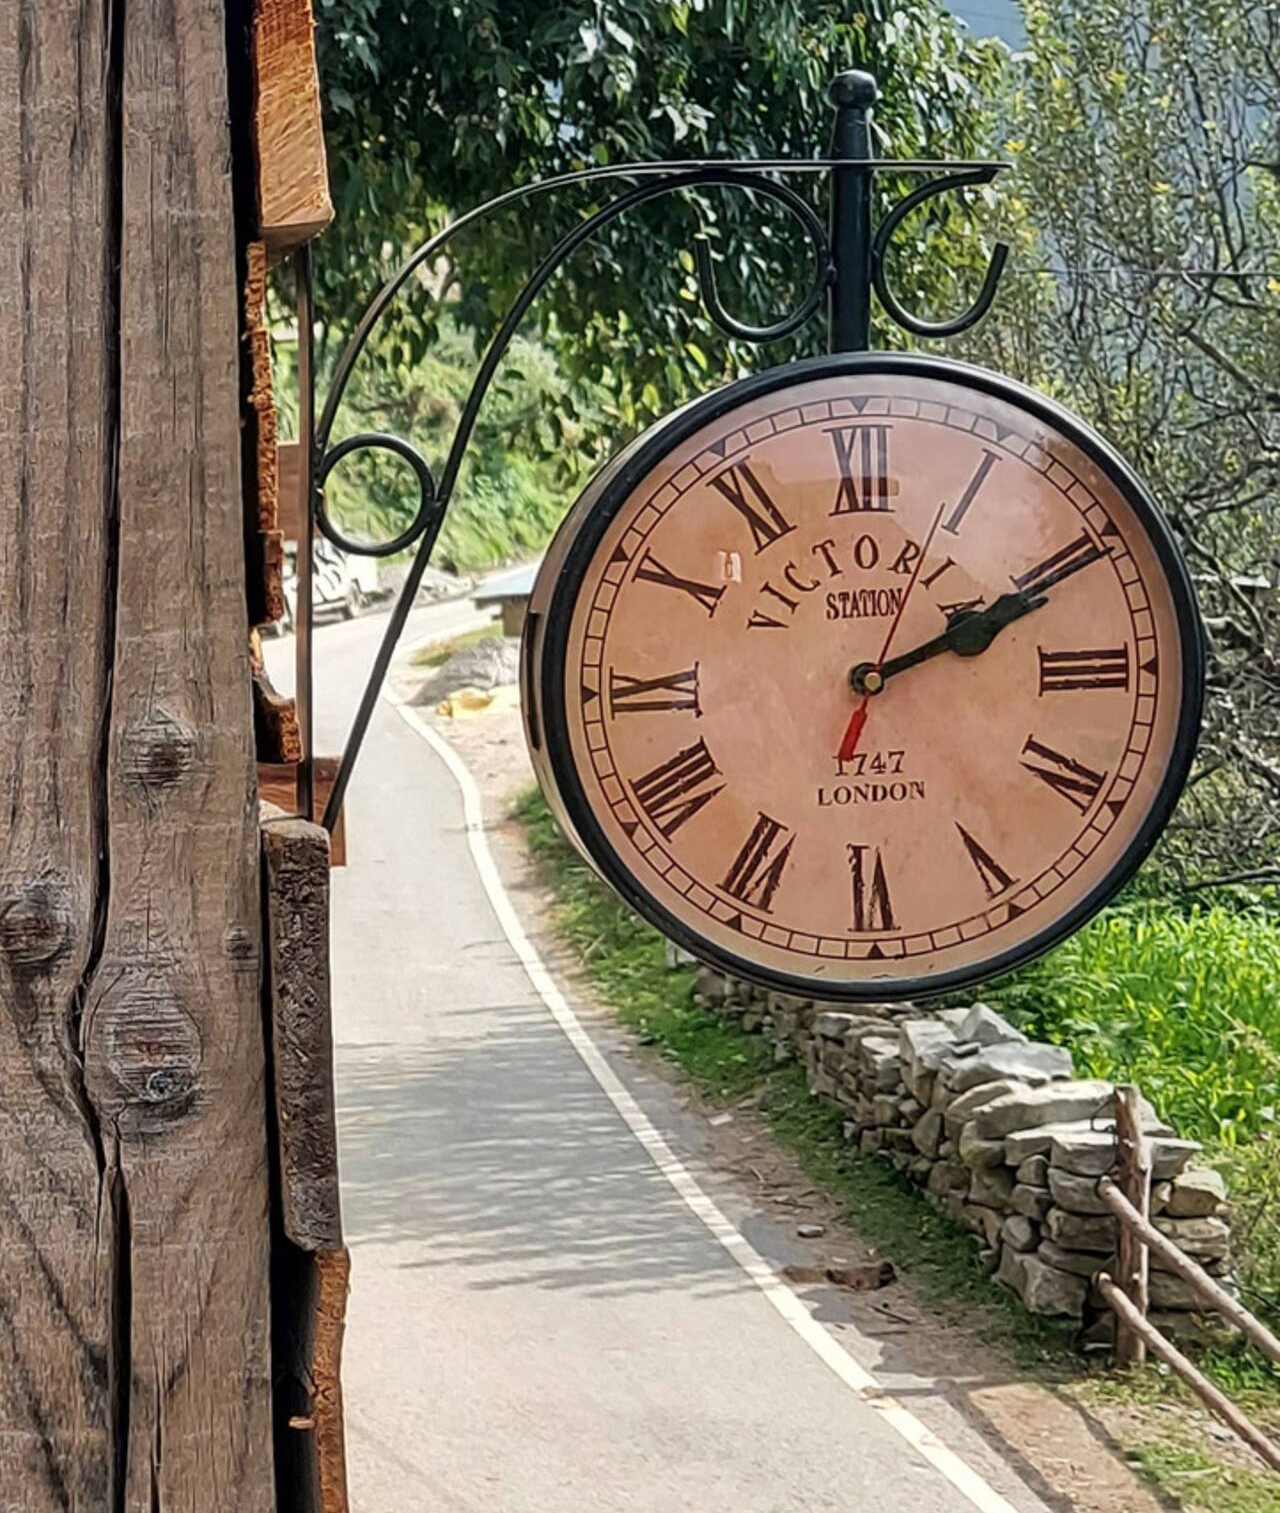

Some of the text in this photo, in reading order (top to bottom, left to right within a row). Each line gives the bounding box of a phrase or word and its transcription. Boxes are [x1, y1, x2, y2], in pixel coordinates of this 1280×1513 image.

[706, 455, 798, 555] XI
[822, 425, 896, 517] XII
[631, 547, 728, 618] X
[826, 588, 903, 620] STATION
[610, 661, 703, 721] IX
[1037, 641, 1130, 697] III
[628, 735, 728, 843] VIII
[818, 780, 925, 806] LONDON
[832, 750, 905, 776] 1747
[1018, 733, 1108, 817] IV
[715, 811, 798, 915] VII
[847, 843, 902, 932] VI
[954, 821, 1021, 901] V
